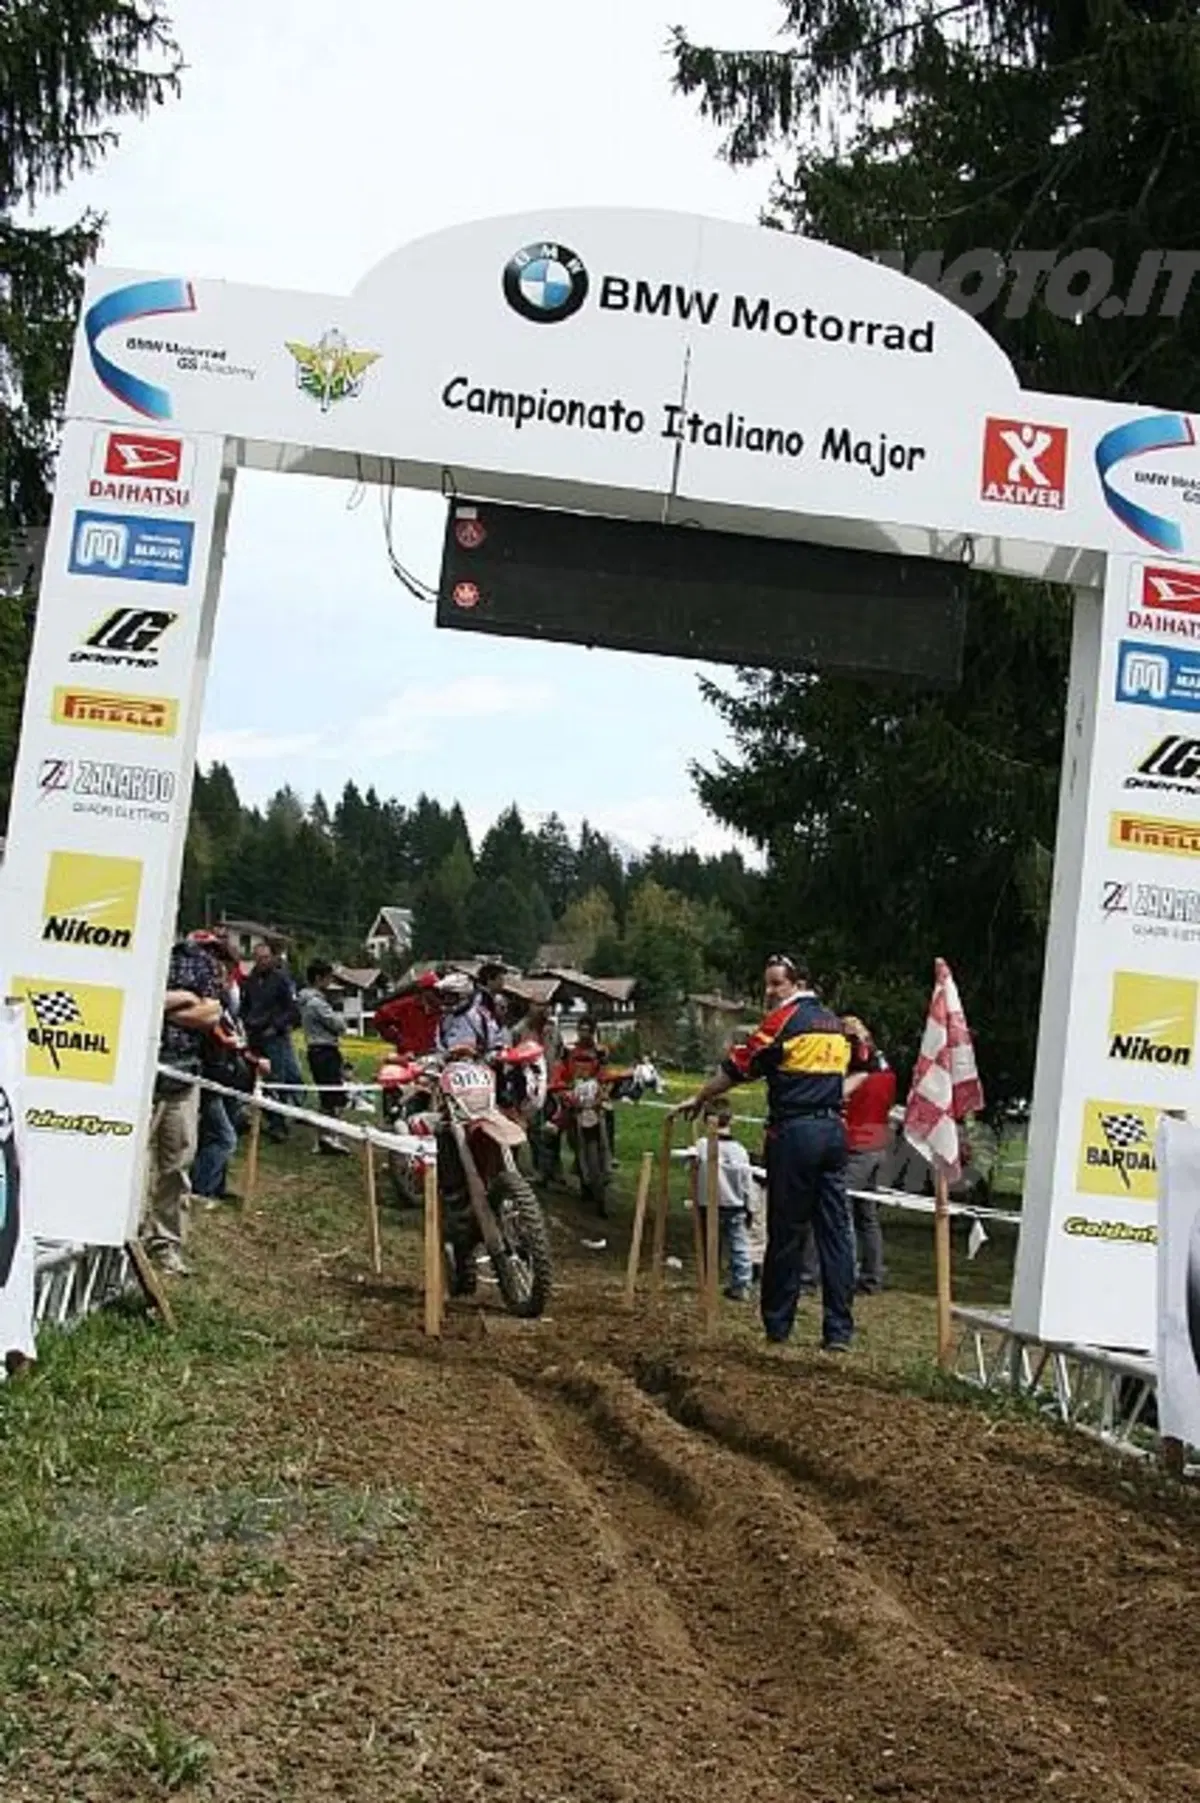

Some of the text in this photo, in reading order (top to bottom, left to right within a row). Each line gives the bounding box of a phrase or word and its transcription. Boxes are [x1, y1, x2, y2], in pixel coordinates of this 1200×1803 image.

[599, 275, 935, 354] BMW Motorrad
[441, 376, 926, 478] Campionato Italiano Major
[89, 480, 190, 506] DAIHATSU
[984, 482, 1062, 507] AXIVER
[1127, 610, 1200, 639] DAIHAT
[64, 695, 166, 727] PIRELLI
[1121, 819, 1200, 851] PIRELL
[43, 915, 132, 948] Nikon
[27, 1027, 110, 1054] ARDAHL
[1109, 1034, 1191, 1066] Nikon
[1087, 1146, 1157, 1172] BARDA
